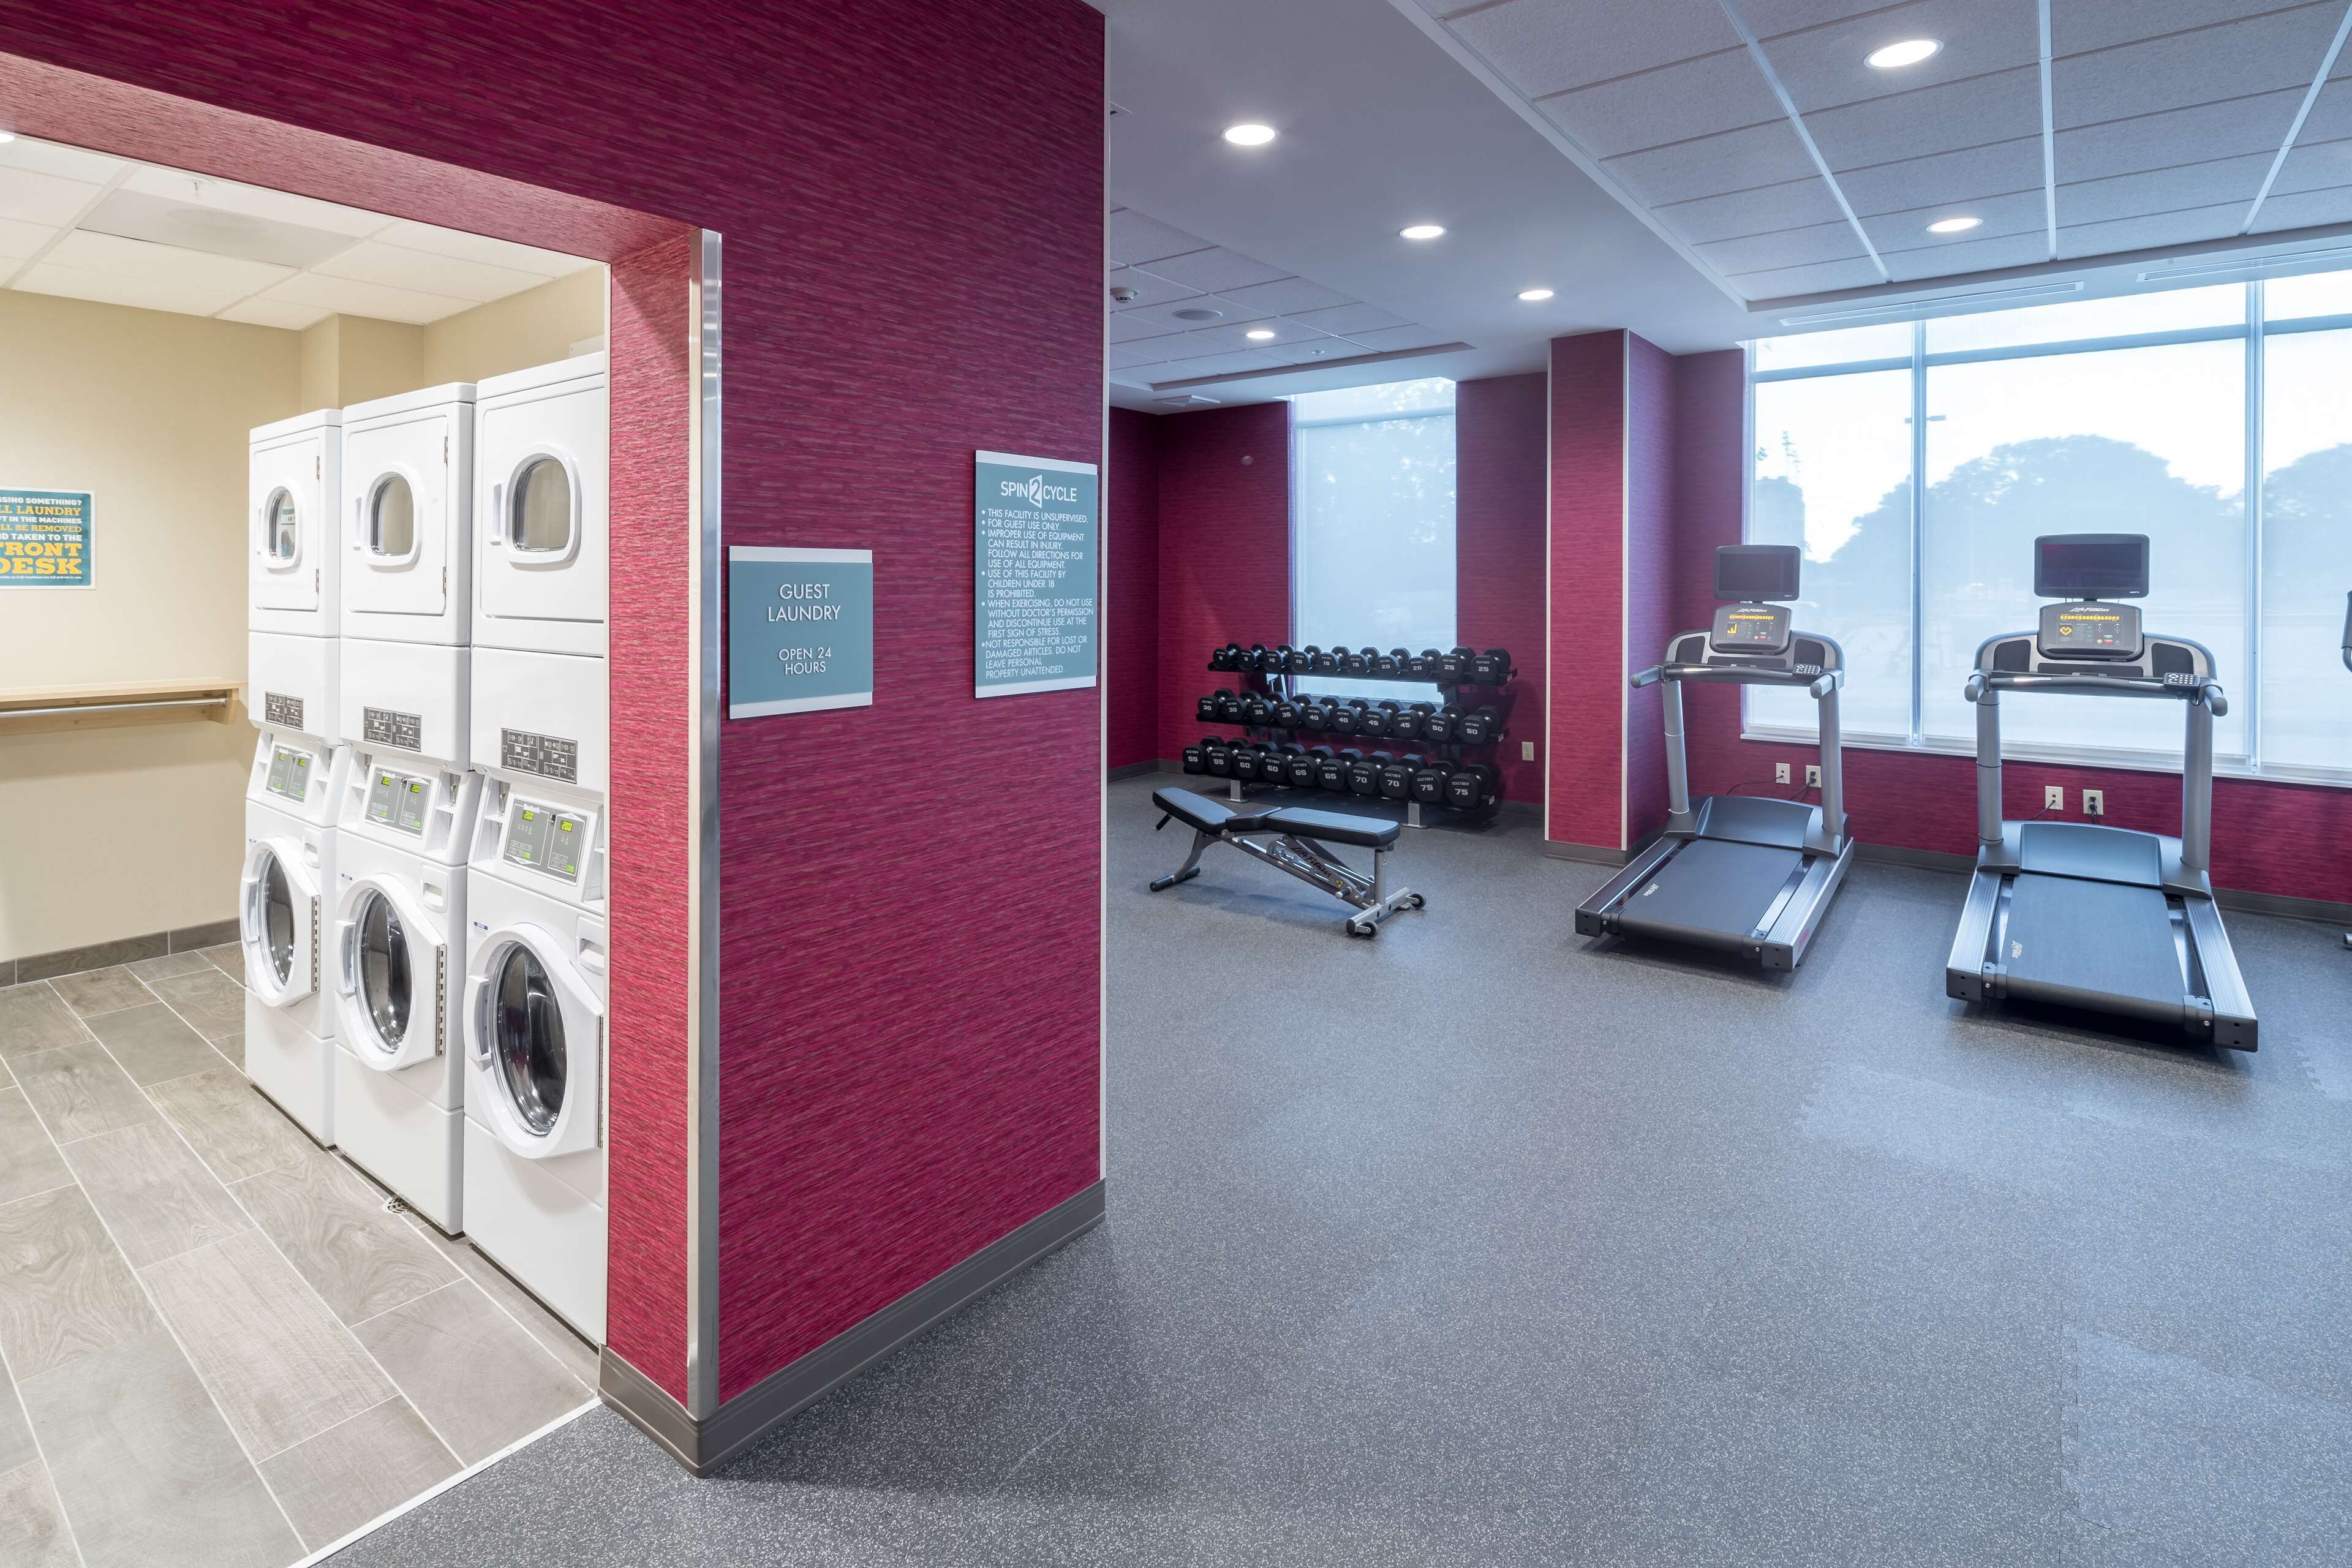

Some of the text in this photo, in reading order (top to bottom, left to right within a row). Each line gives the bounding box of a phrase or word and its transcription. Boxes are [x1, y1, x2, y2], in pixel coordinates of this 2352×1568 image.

[1001, 478, 1077, 505] SPIN 2 CYCLE
[17, 505, 81, 516] LAUNDRY
[1005, 510, 1031, 519] FACILITY
[1034, 511, 1039, 520] IS
[1041, 513, 1088, 523] UNSUPERVISED.
[988, 519, 1001, 527] FOR
[988, 529, 1021, 538] IMPROPER
[1007, 540, 1029, 548] RESULT
[780, 584, 829, 599] GUEST
[1012, 599, 1052, 608] EXERCISING,
[768, 605, 840, 622] LAUNDRY
[988, 609, 1020, 618] WITHOUT
[1006, 618, 1051, 627] DISCONTINUE
[986, 640, 1001, 649] NOT
[1003, 638, 1045, 647] RESPONSIBLE
[779, 647, 831, 660] OPEN 24
[986, 649, 1022, 658] DAMAGED
[1023, 647, 1053, 656] ARTICLES.
[785, 662, 826, 675] HOURS
[986, 658, 1042, 669] LEAVE PERSONAL
[986, 665, 1065, 679] PROPERTY UNATTENDED.
[1291, 848, 1331, 877] Life Fitness
